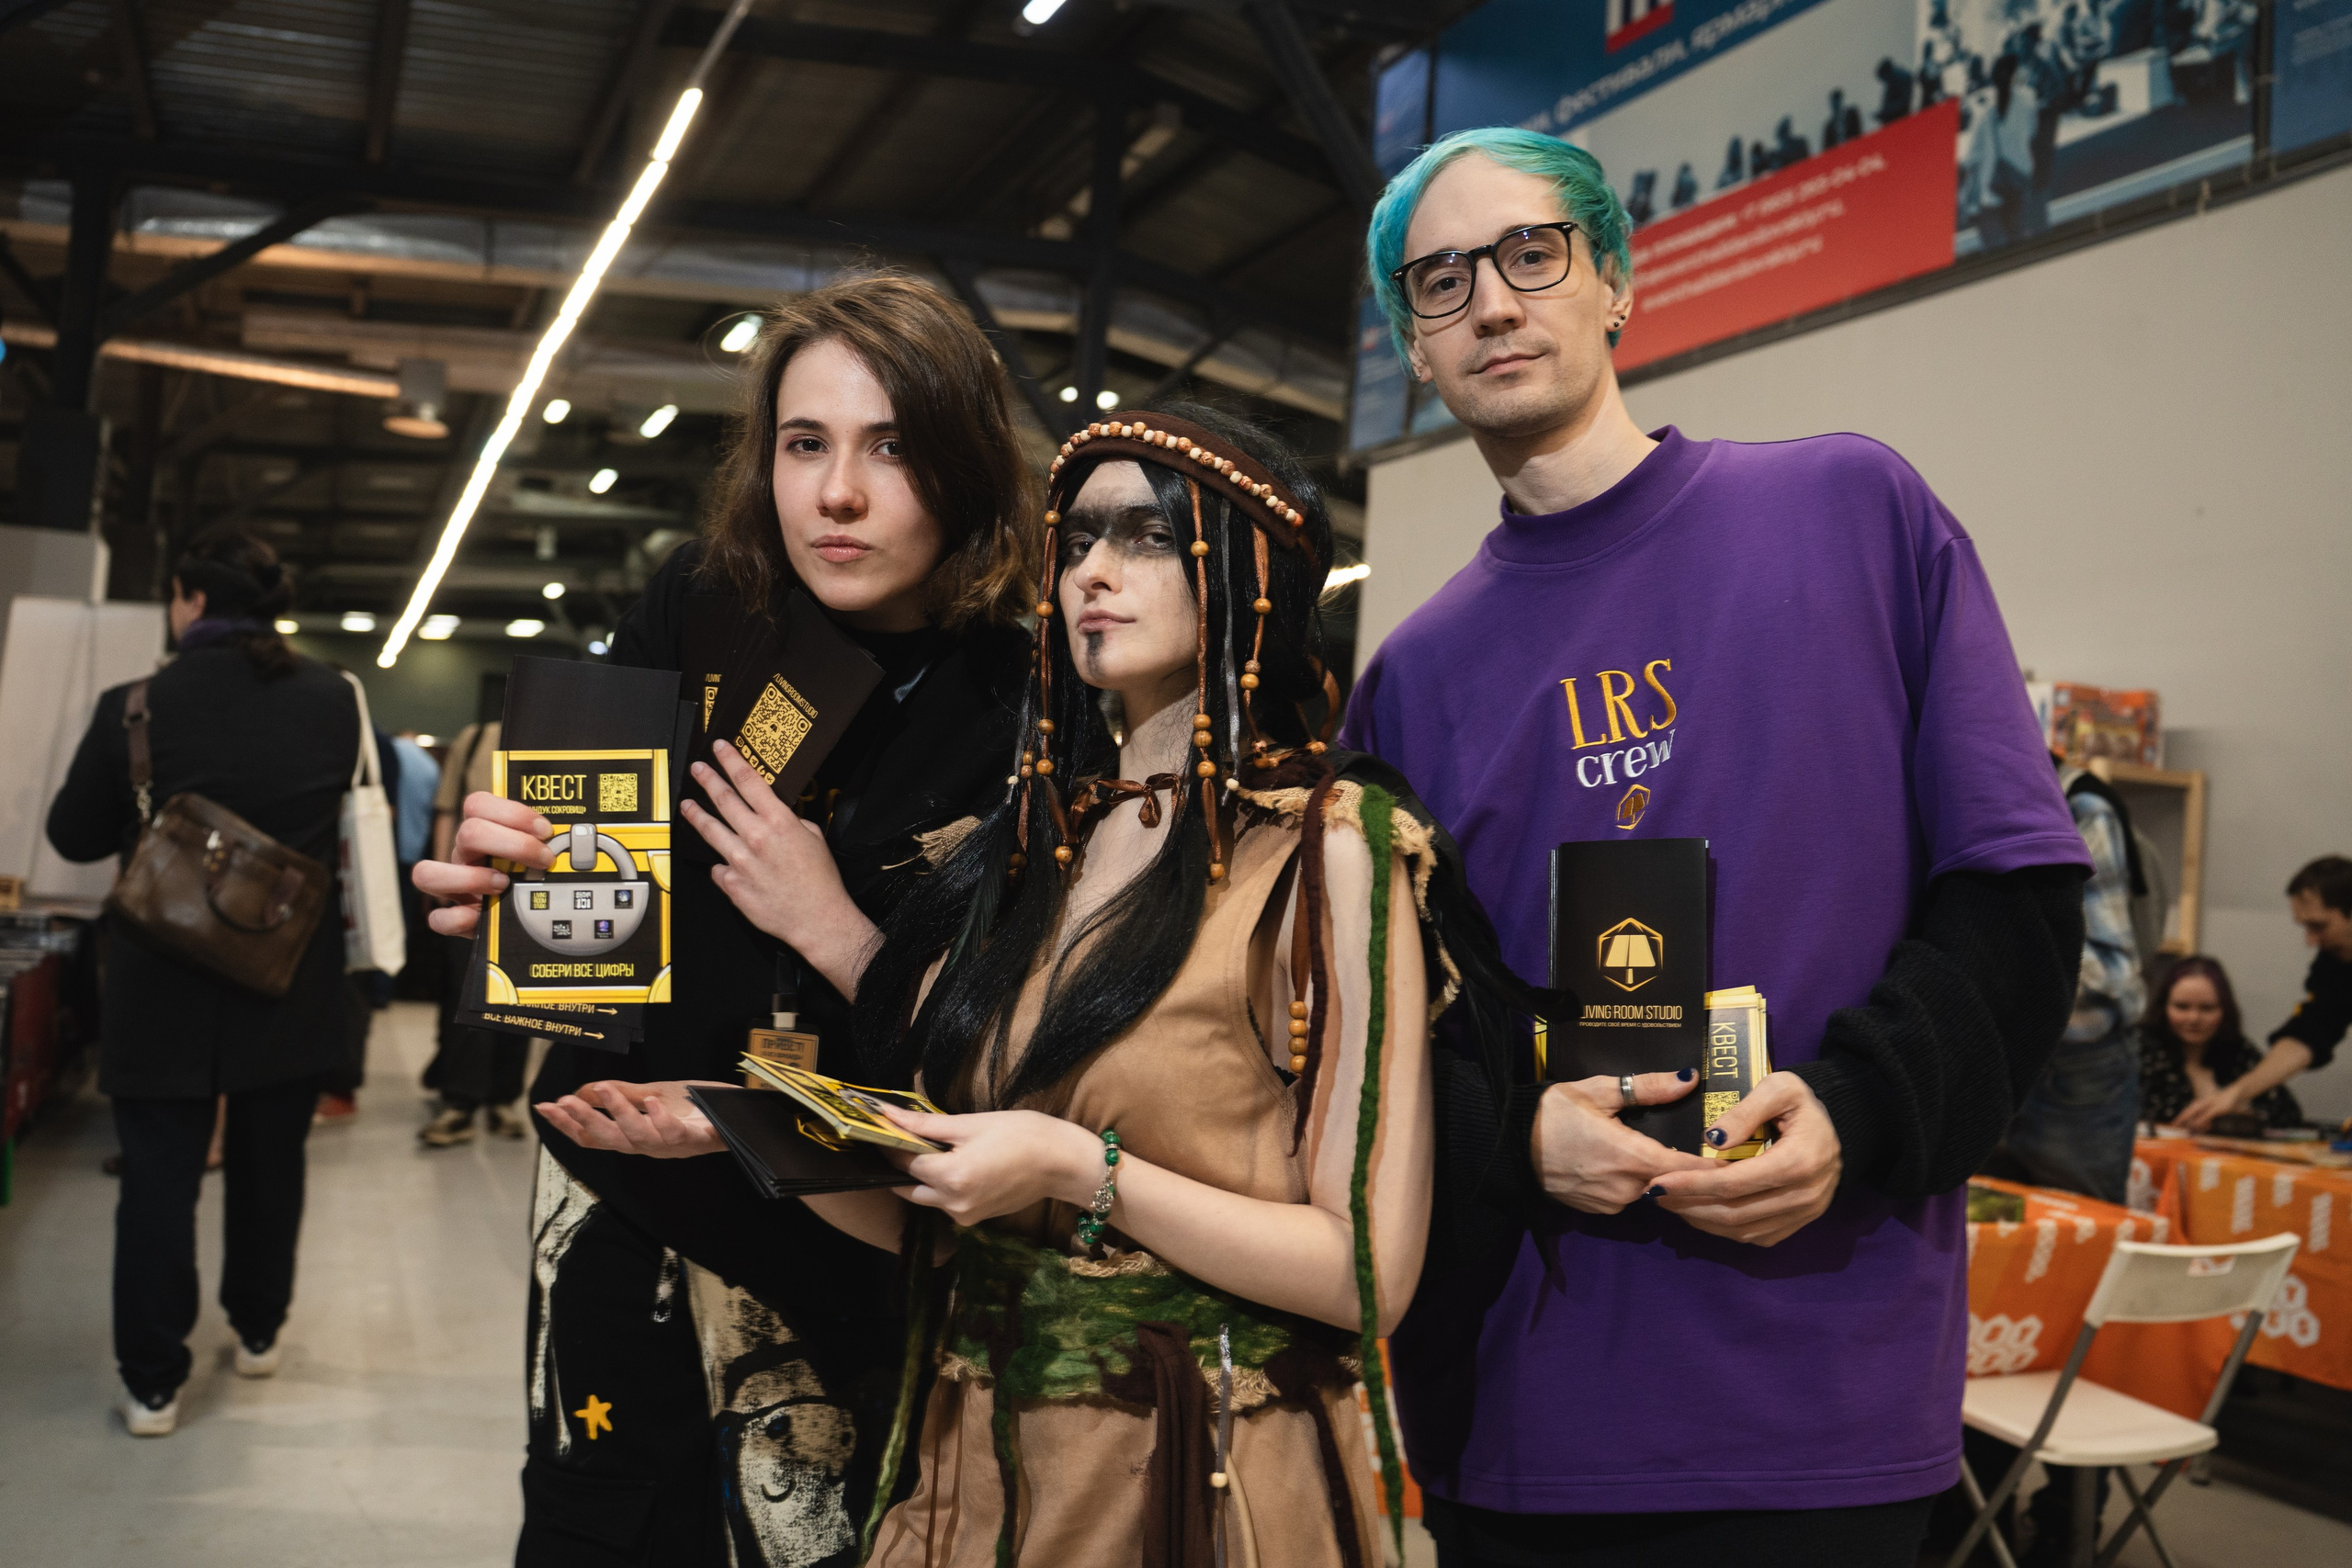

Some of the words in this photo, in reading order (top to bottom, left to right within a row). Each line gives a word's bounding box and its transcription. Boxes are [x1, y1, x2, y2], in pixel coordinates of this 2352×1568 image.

[1559, 658, 1677, 750] LRS
[1576, 728, 1676, 788] crew
[521, 774, 587, 800] КВЕСТ
[530, 964, 572, 978] СОБЕРИ
[573, 963, 594, 977] ВСЕ
[595, 963, 635, 978] ЦИФРЫ
[558, 1002, 595, 1014] ВНУТРИ
[1612, 1004, 1644, 1020] ROOM
[1645, 1005, 1683, 1021] STUDIO
[504, 1014, 545, 1030] ВАЖНОЕ
[545, 1021, 582, 1037] ВНУТРИ
[1711, 1021, 1739, 1079] КВЕСТ
